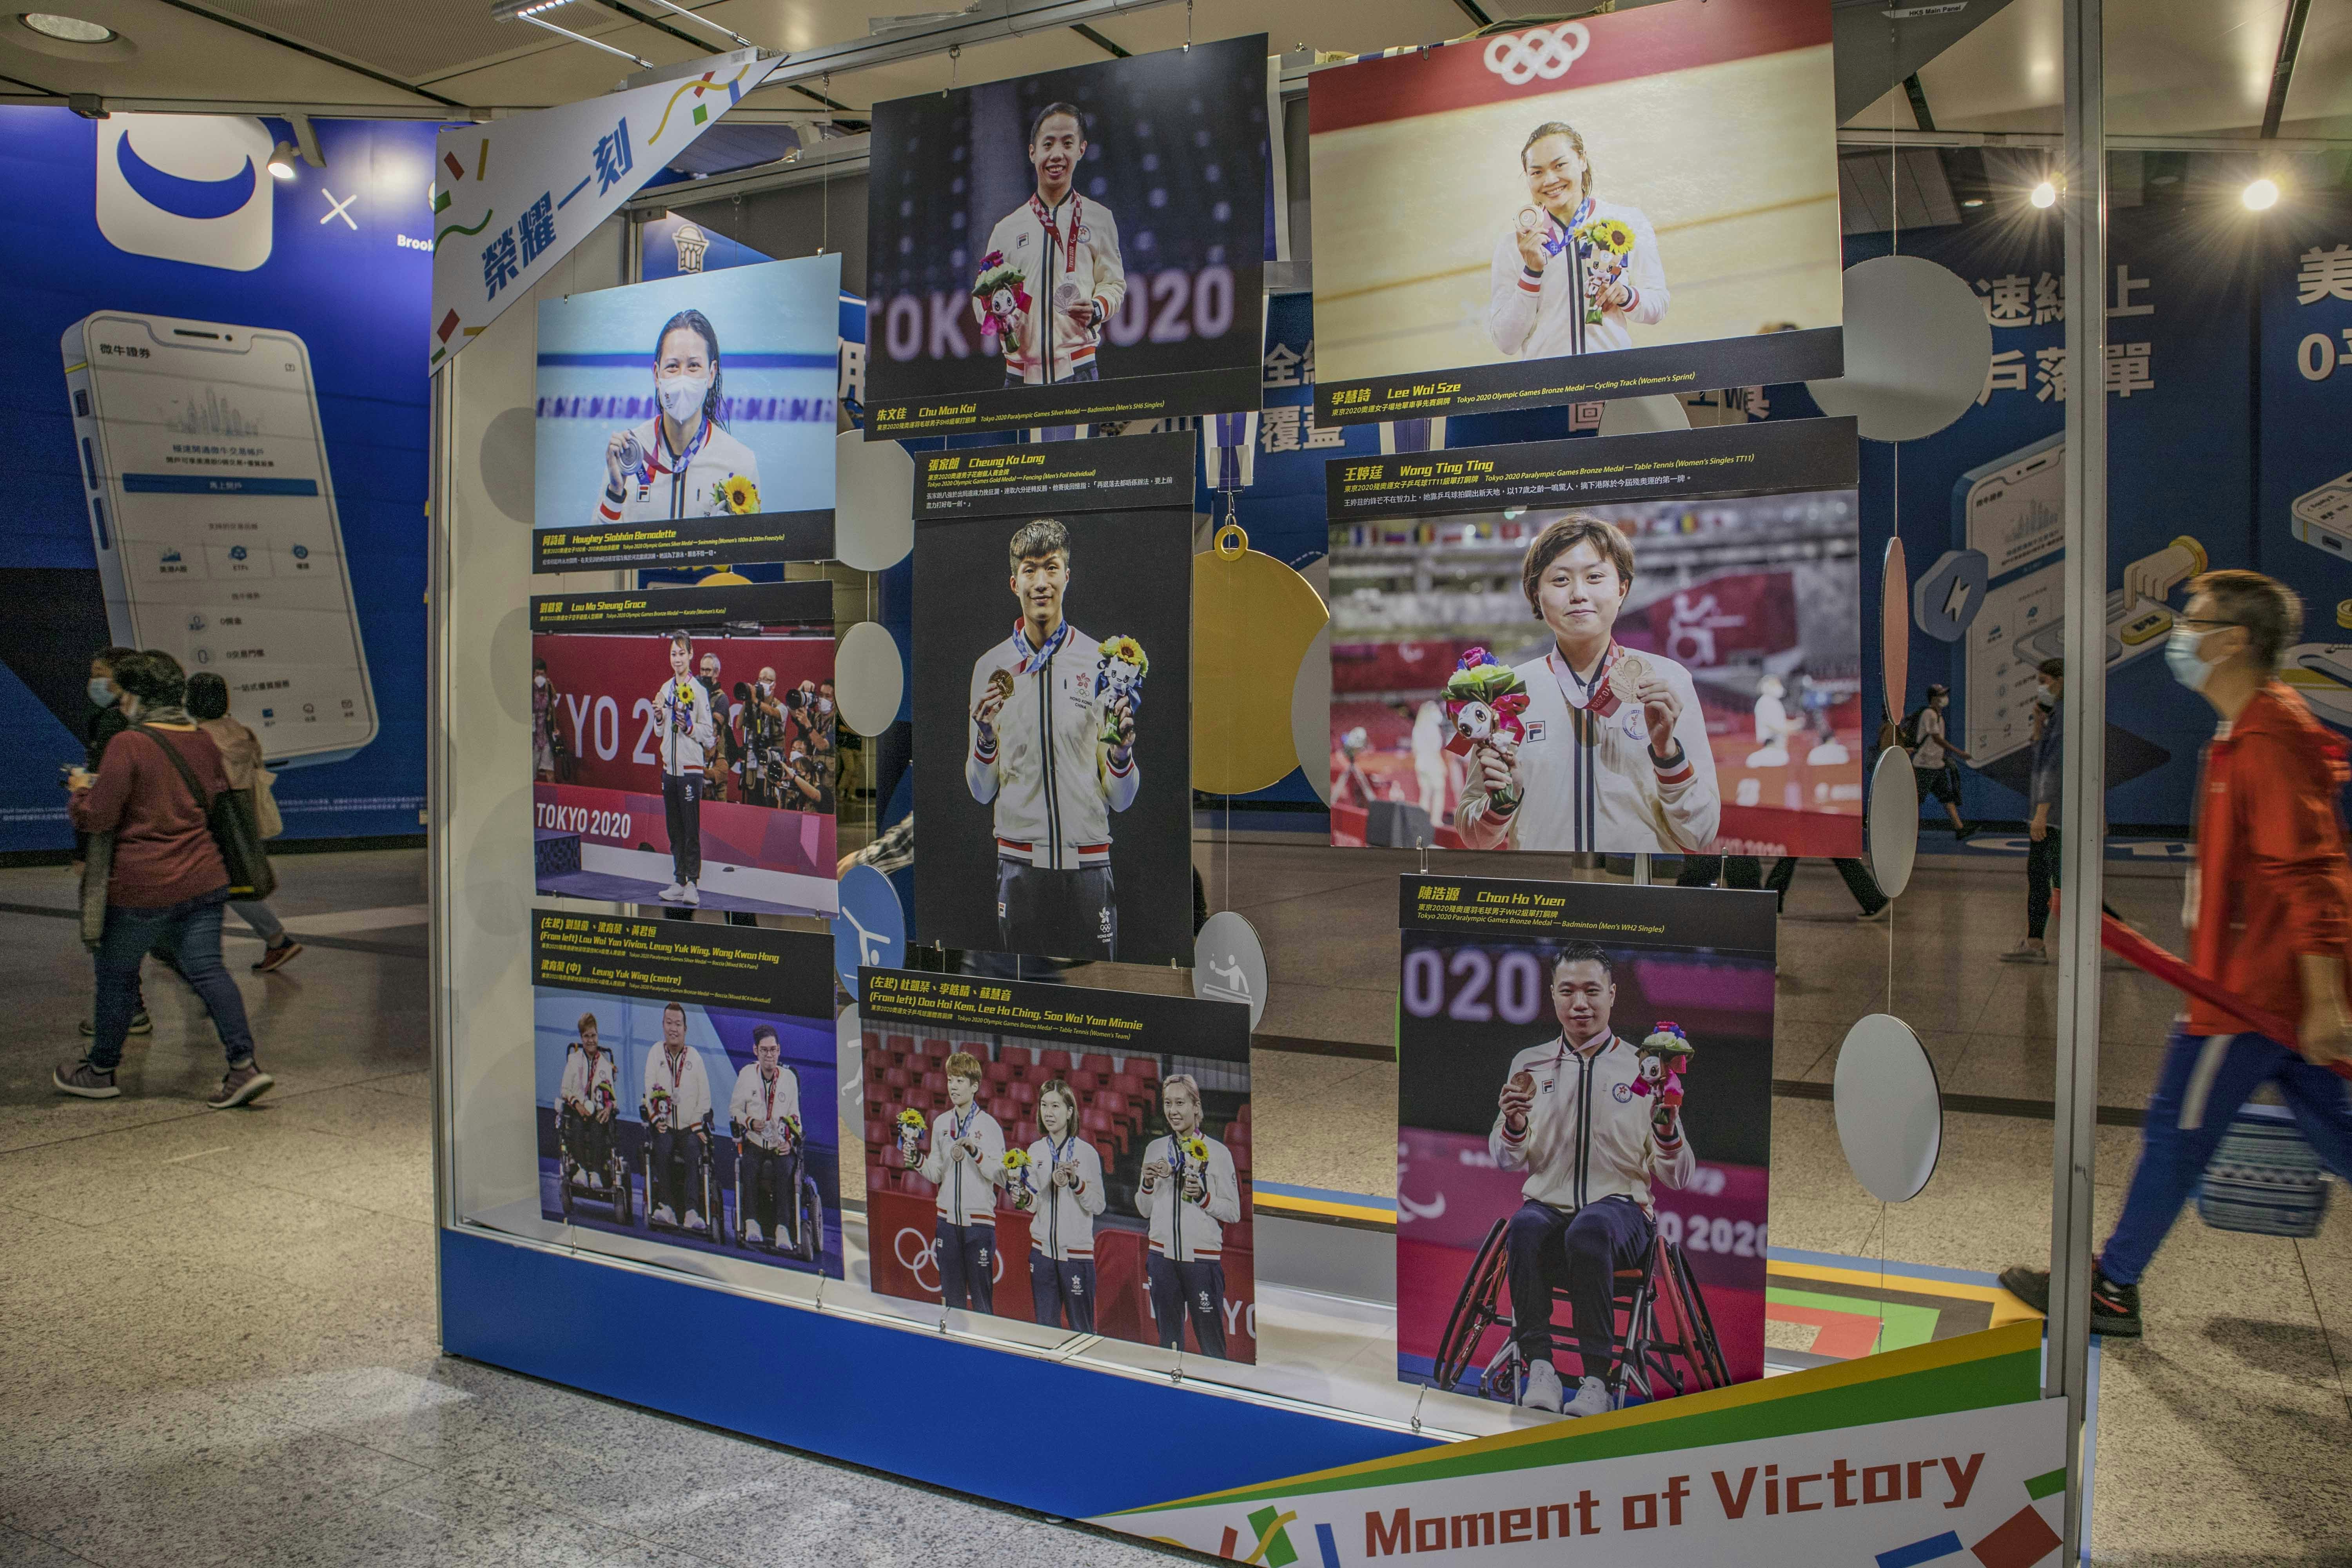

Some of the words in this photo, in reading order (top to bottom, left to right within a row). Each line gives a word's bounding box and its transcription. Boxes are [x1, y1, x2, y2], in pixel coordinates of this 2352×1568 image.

[481, 116, 633, 301] 榮耀一刻
[1101, 267, 1237, 347] 020
[2298, 328, 2352, 381] 0
[1263, 339, 1314, 388] 全
[1387, 389, 1409, 399] Lee
[1413, 384, 1435, 396] Wai
[1436, 383, 1461, 393] Sze
[1492, 392, 1518, 400] Olympic
[1594, 381, 1618, 390] Cycling
[1638, 376, 1670, 385] (Women's
[1671, 372, 1695, 382] Sprint)
[1332, 388, 1371, 405] 李慧詩
[919, 408, 936, 417] Chu
[938, 406, 958, 415] Man
[960, 404, 976, 413] Kai
[1144, 401, 1164, 409] Singles)
[877, 408, 906, 421] 朱文佳
[928, 458, 960, 471] 張家朗
[969, 458, 1004, 467] Cheung
[1006, 456, 1019, 465] Ka
[1020, 455, 1045, 464] Long
[1400, 466, 1432, 477] Wong
[1436, 463, 1463, 474] Ting
[1466, 460, 1494, 472] Ting
[1675, 459, 1708, 468] (Women's
[1736, 454, 1754, 462] TT11)
[572, 535, 603, 544] Haughey
[604, 533, 633, 541] Siobhán
[634, 530, 676, 540] Bernadette
[597, 602, 623, 611] Sheung
[537, 803, 588, 833] TOKYO
[592, 810, 631, 839] 2020
[1417, 886, 1461, 900] 陳浩源
[1477, 892, 1509, 903] Chan
[1512, 894, 1530, 904] Ho
[1534, 895, 1566, 906] Yuen
[1452, 914, 1486, 922] Paralympic
[1638, 925, 1664, 933] Singles)
[541, 931, 561, 940] (From
[562, 934, 577, 943] left)
[579, 935, 591, 944] Lau
[608, 938, 621, 946] Yan
[623, 939, 648, 949] Vivian,
[649, 942, 672, 953] Leung
[674, 944, 688, 953] Yuk
[690, 946, 710, 956] Wing,
[712, 948, 733, 959] Wong
[735, 950, 757, 959] Kwan
[758, 952, 779, 964] Hang
[566, 963, 581, 975] (中)
[592, 967, 614, 978] Leung
[616, 970, 629, 978] Yuk
[631, 972, 648, 982] Wing
[650, 973, 681, 985] (centre)
[870, 992, 895, 1002] (From
[897, 995, 916, 1007] left)
[918, 997, 935, 1007] Doo
[937, 999, 953, 1009] Hoi
[954, 1001, 976, 1012] Kem,
[978, 1004, 995, 1013] Lee
[997, 1006, 1010, 1015] Ho
[1011, 1007, 1041, 1020] Ching,
[1044, 1011, 1063, 1021] Soo
[1065, 1013, 1083, 1023] Wai
[1086, 1015, 1105, 1025] Yam
[1109, 1018, 1143, 1030] Minnie
[1090, 1029, 1113, 1038] (Women's
[1365, 1490, 1599, 1557] Moment
[1622, 1475, 1689, 1530] of
[1713, 1454, 1984, 1518] Victory
